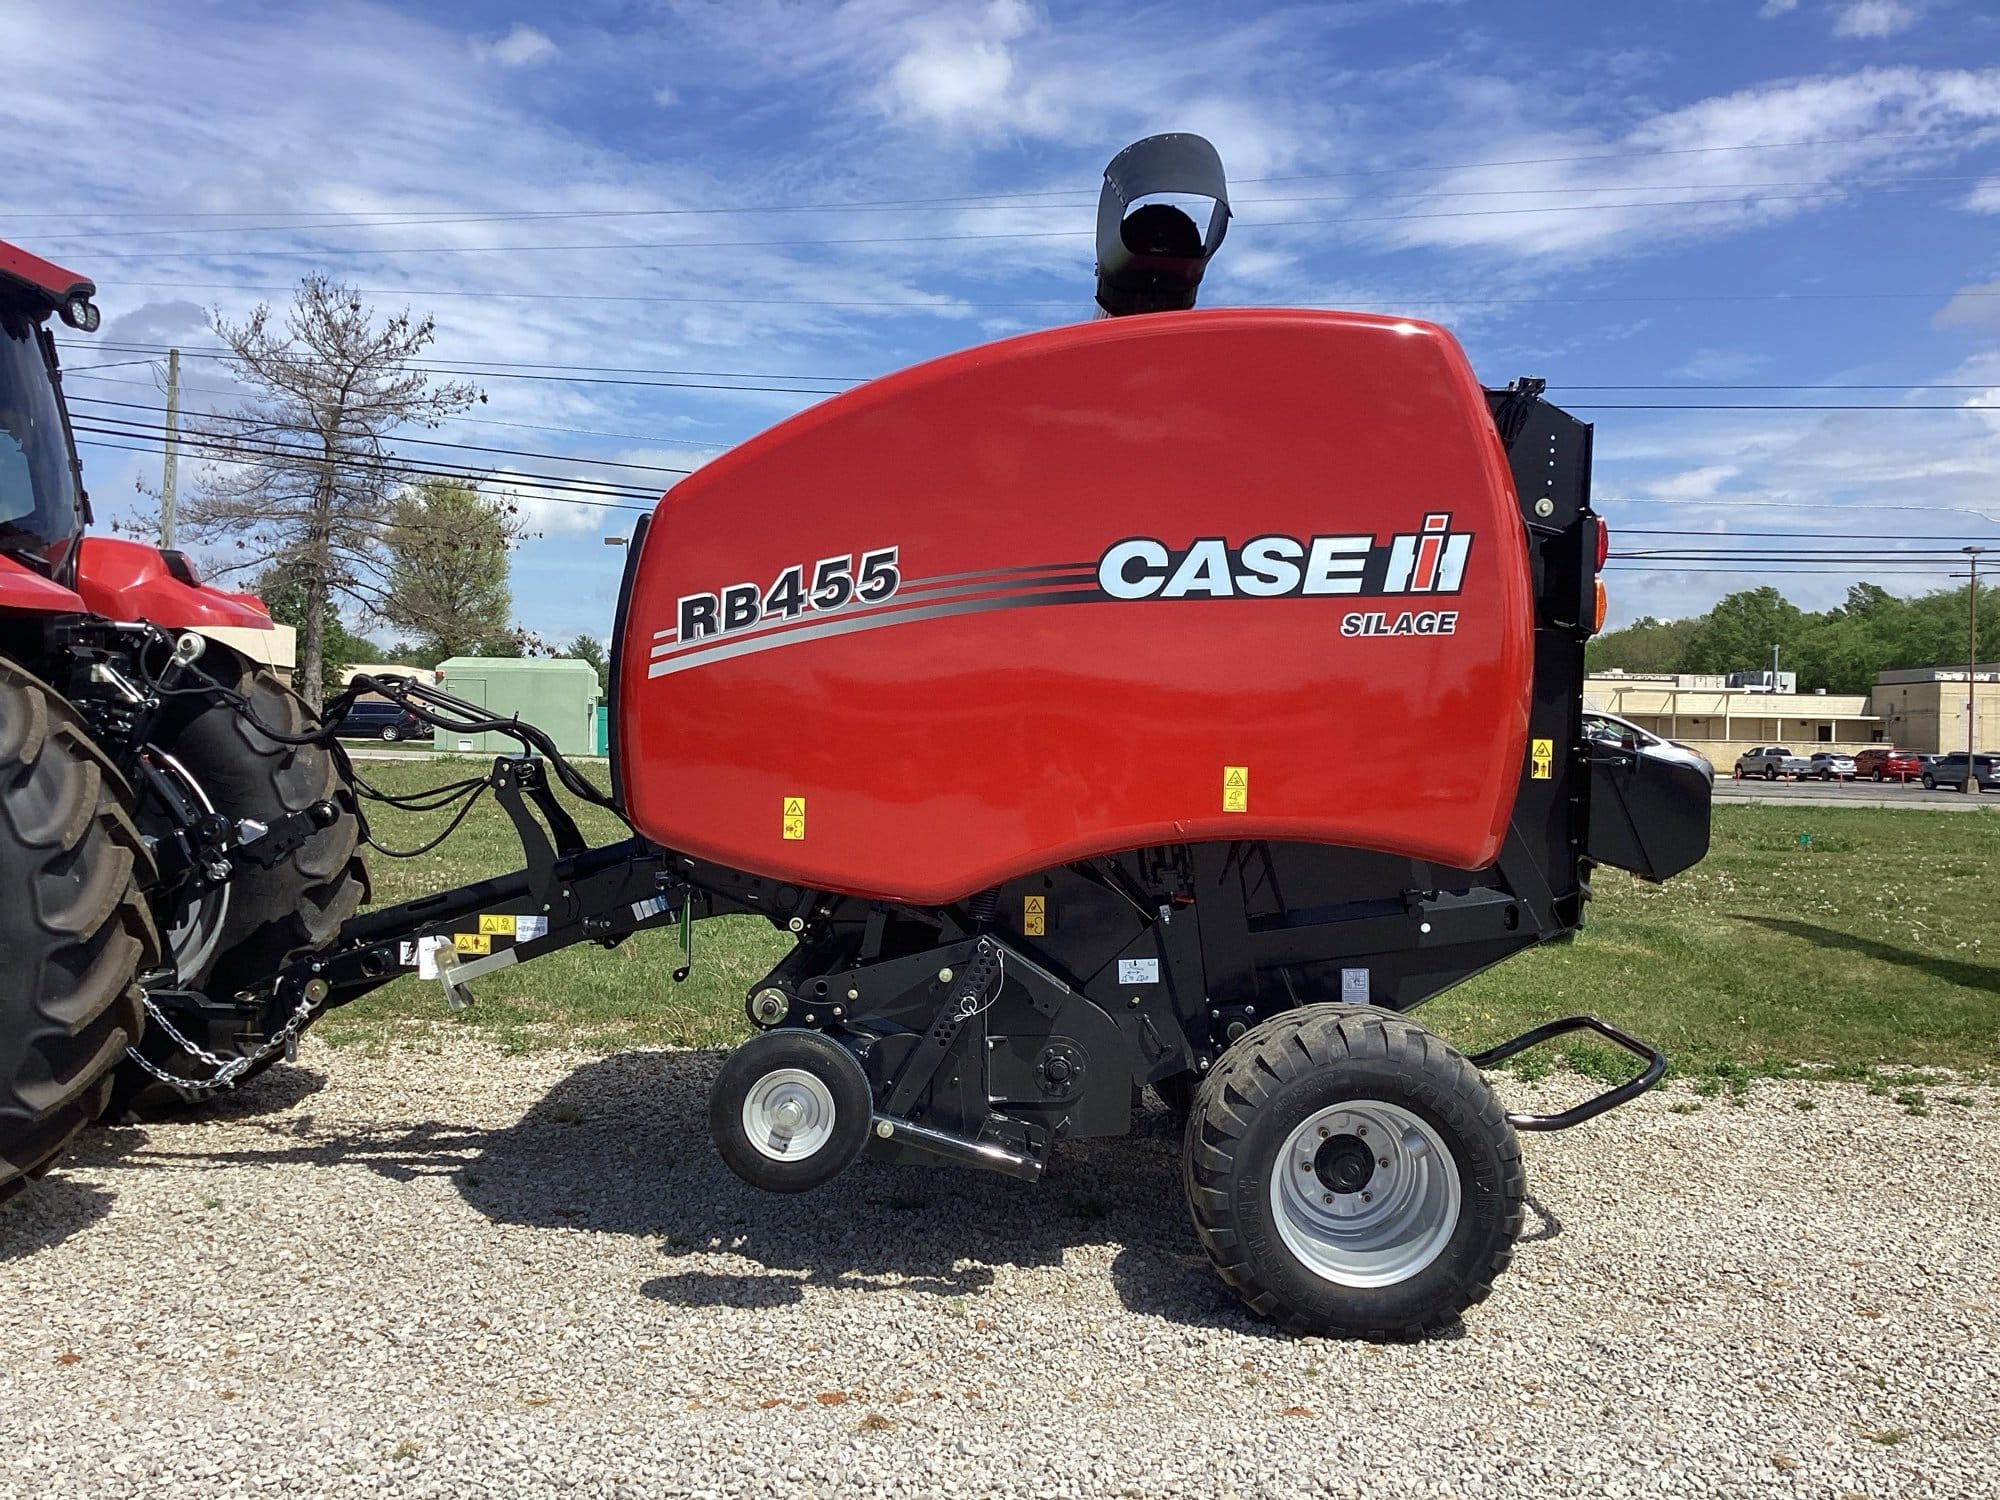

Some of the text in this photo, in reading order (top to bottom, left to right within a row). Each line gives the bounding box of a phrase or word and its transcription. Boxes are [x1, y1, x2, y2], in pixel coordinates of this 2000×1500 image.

[677, 545, 900, 645] RB455
[1099, 537, 1373, 599] CASE
[1340, 611, 1459, 637] SILAGE
